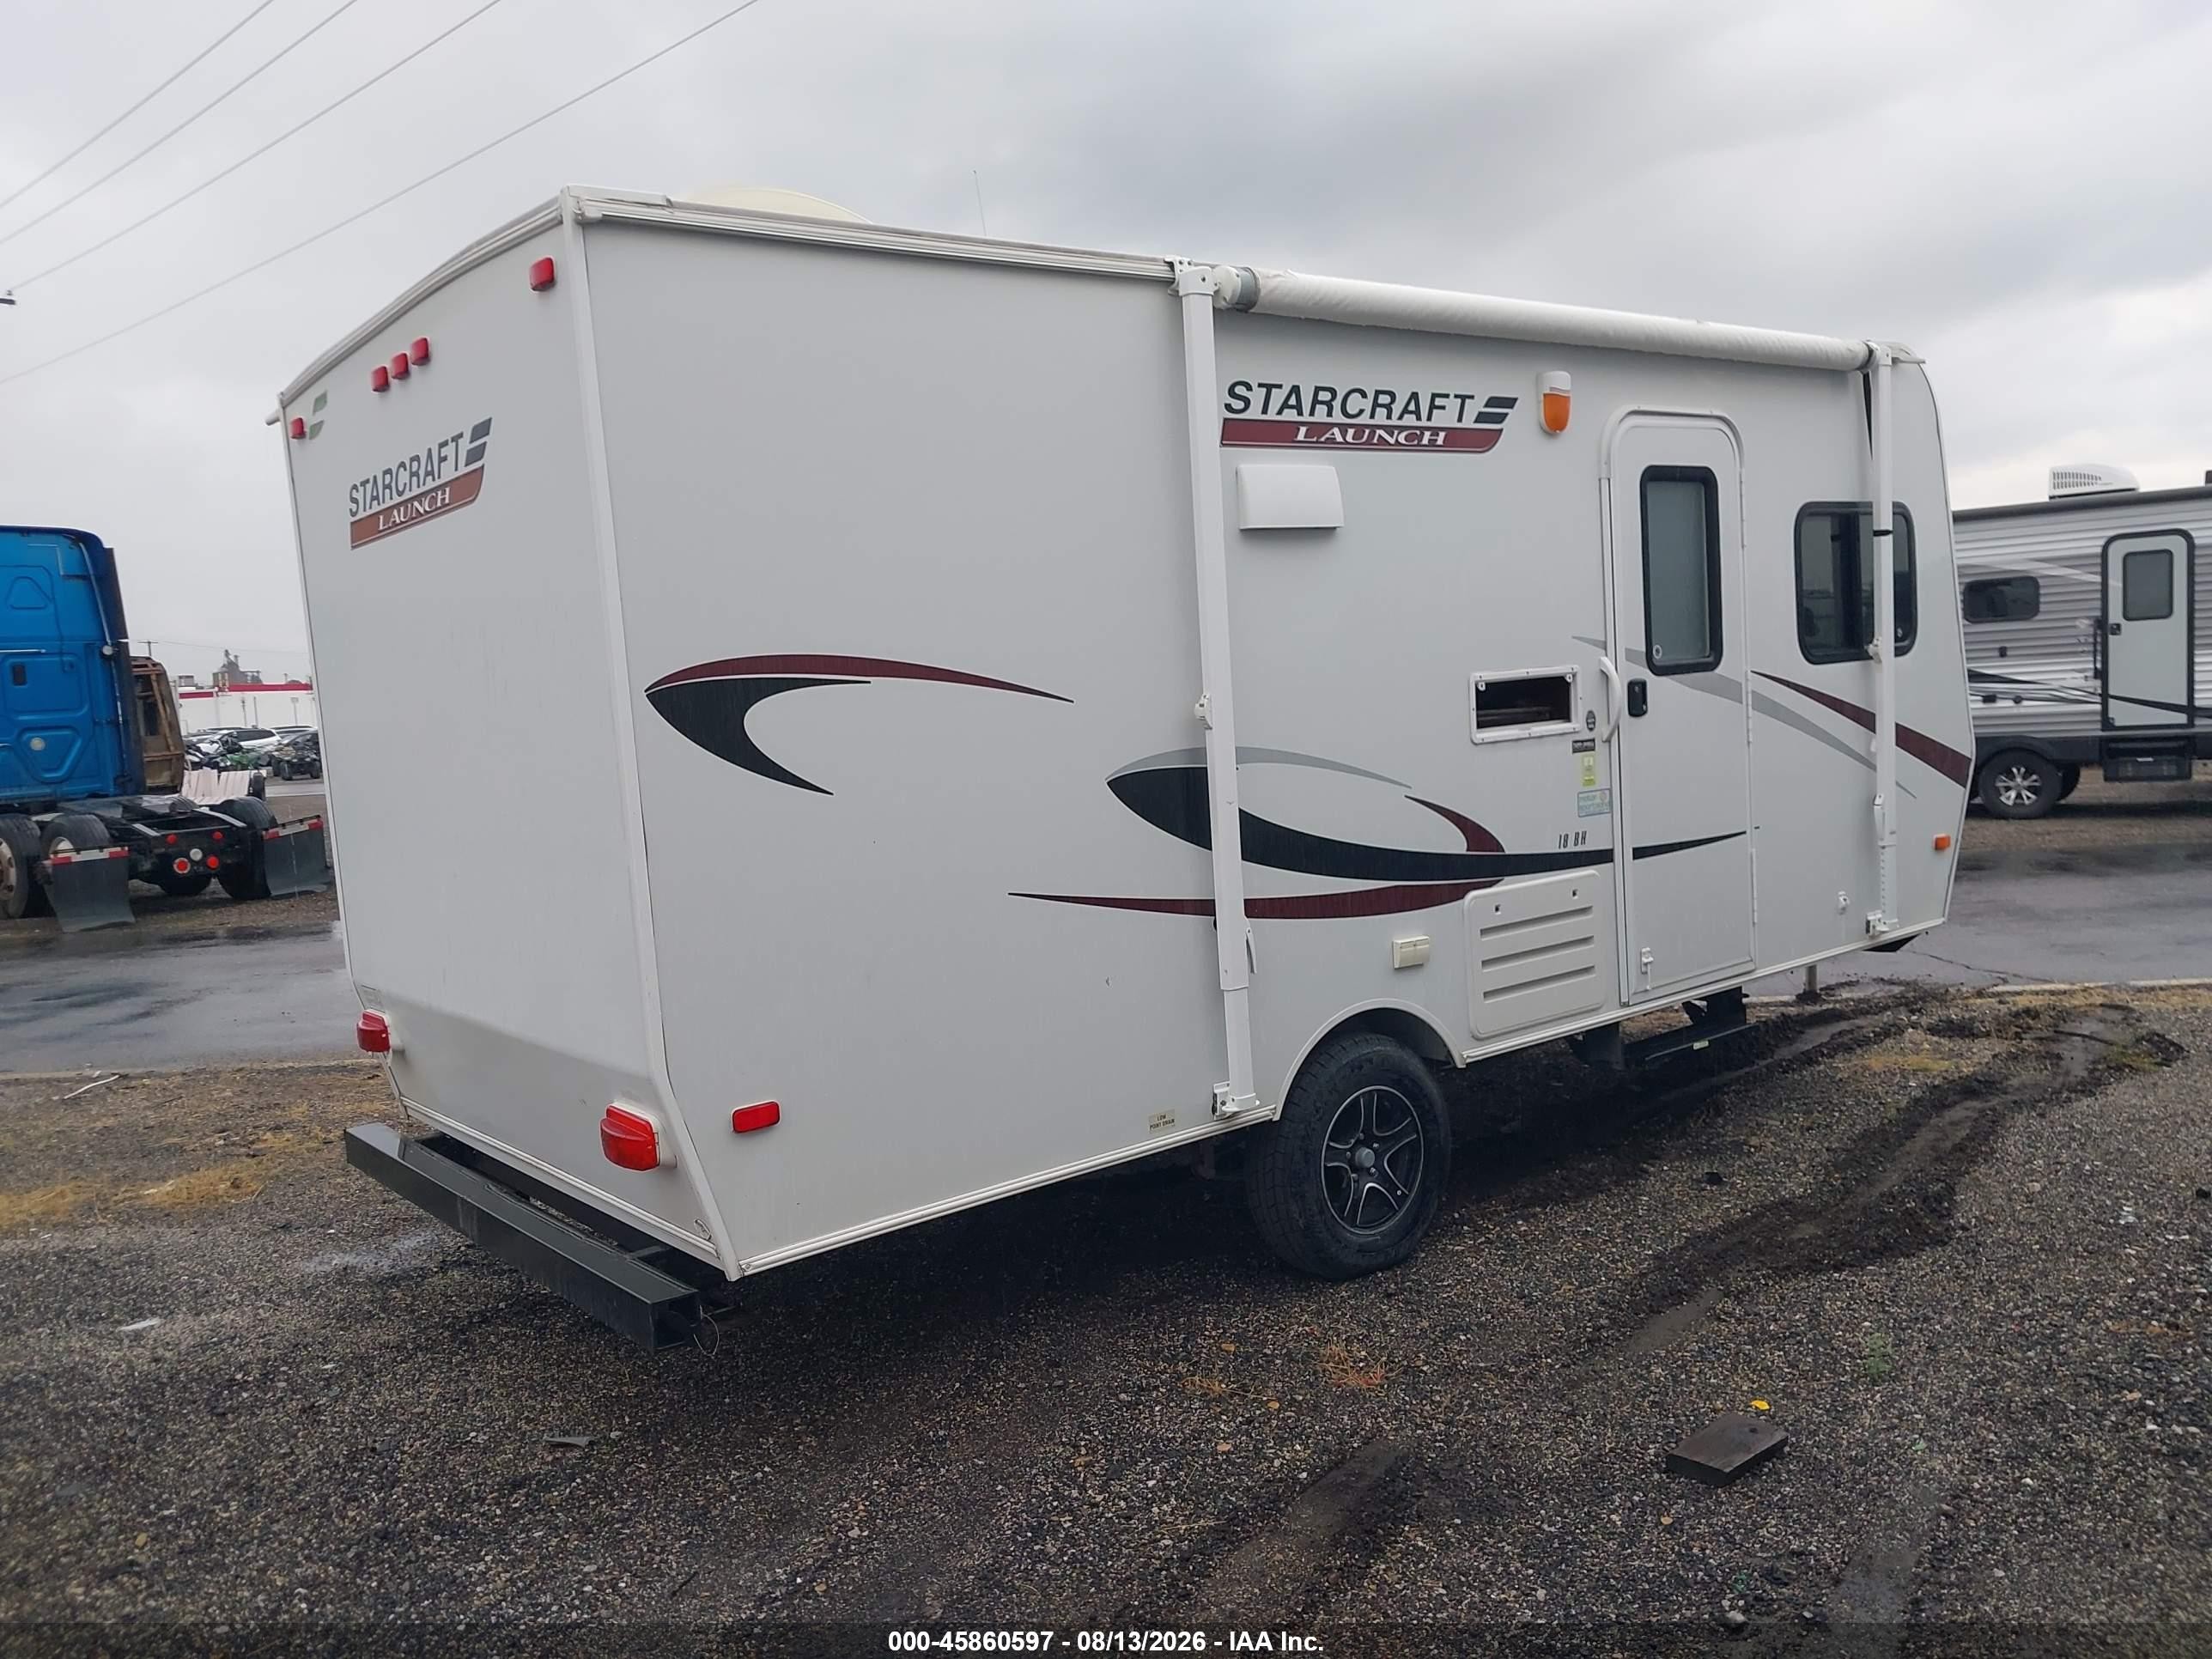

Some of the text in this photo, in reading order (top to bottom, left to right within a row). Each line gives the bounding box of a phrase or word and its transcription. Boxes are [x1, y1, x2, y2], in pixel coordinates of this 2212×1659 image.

[1224, 380, 1475, 423] STARCRAFT
[1293, 425, 1447, 447] LAUNCH
[349, 431, 465, 518] STARCRAFT
[378, 486, 451, 531] LAUNCH
[1558, 830, 1587, 849] 18 BH
